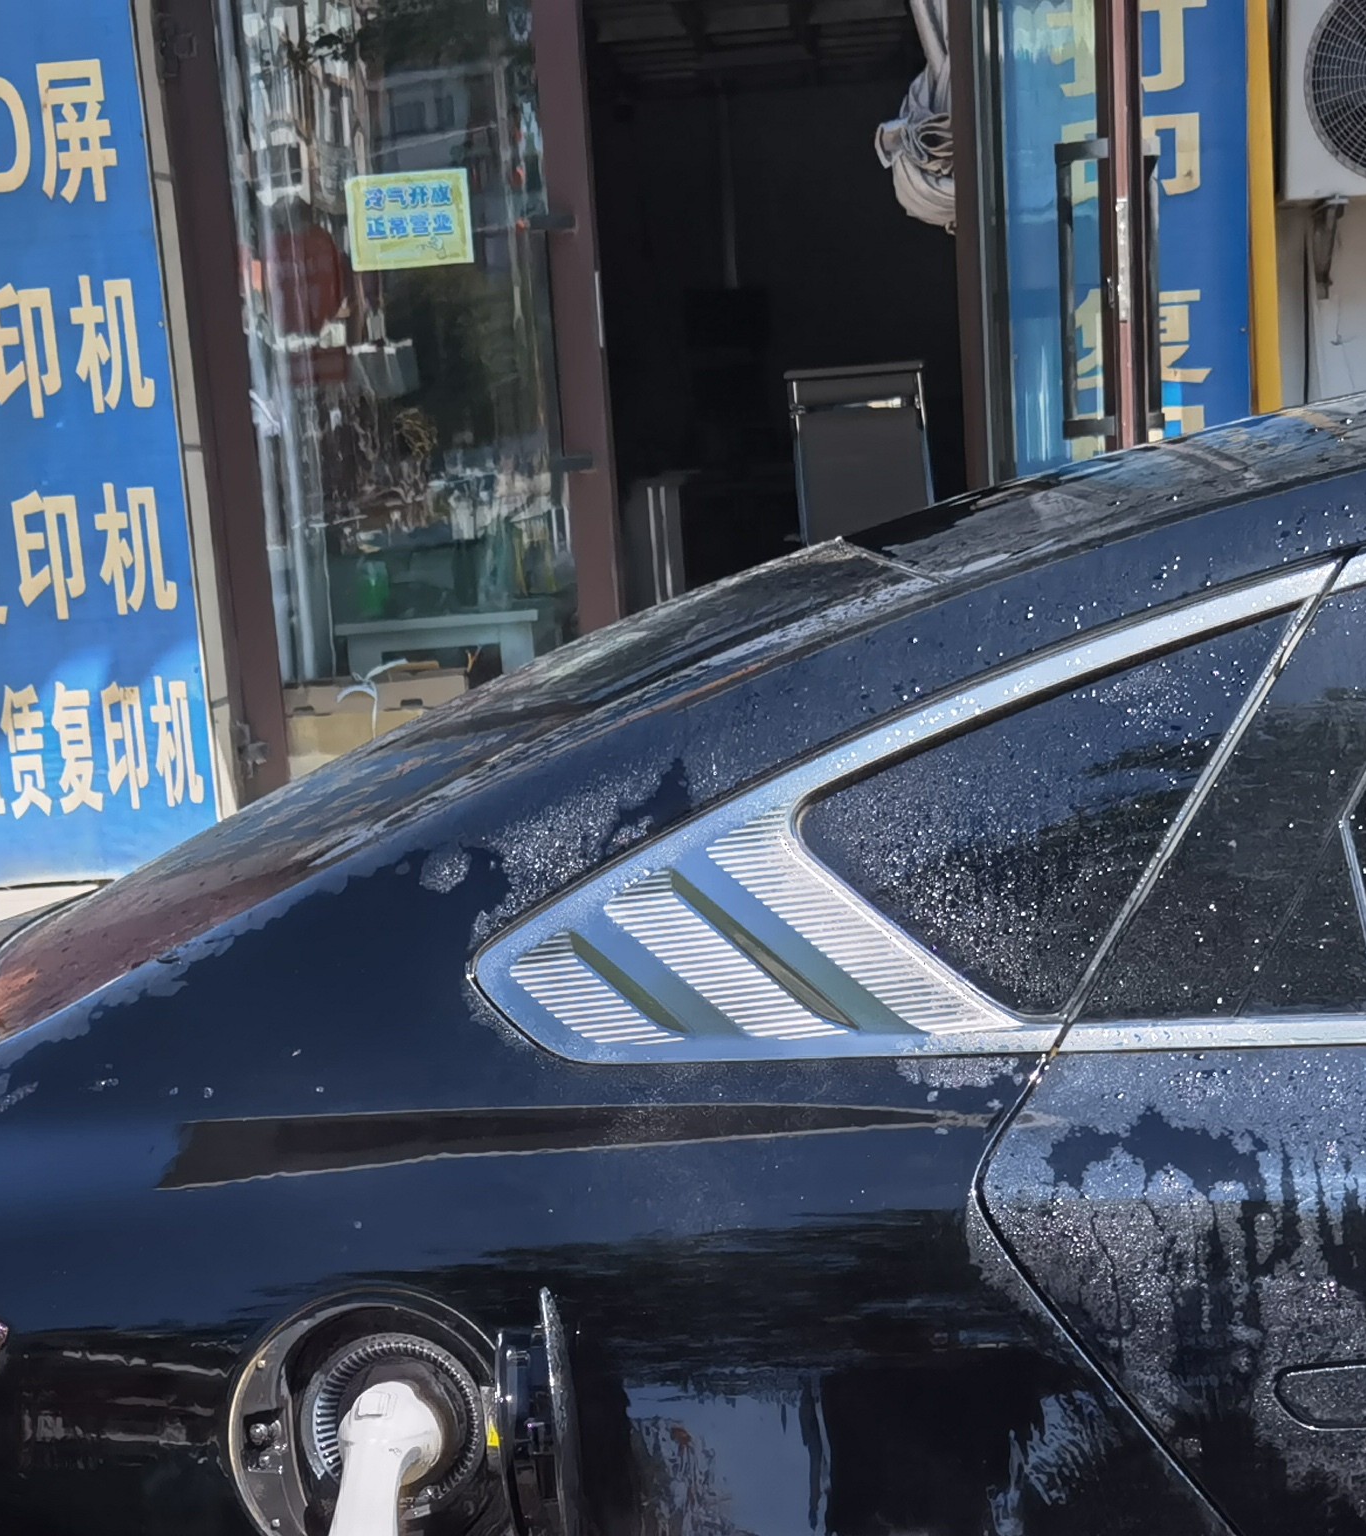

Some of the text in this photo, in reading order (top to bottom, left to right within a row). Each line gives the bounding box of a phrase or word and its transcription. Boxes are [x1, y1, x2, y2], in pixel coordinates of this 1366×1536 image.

[364, 181, 452, 211] 冷气开放
[366, 210, 454, 240] 正常营业
